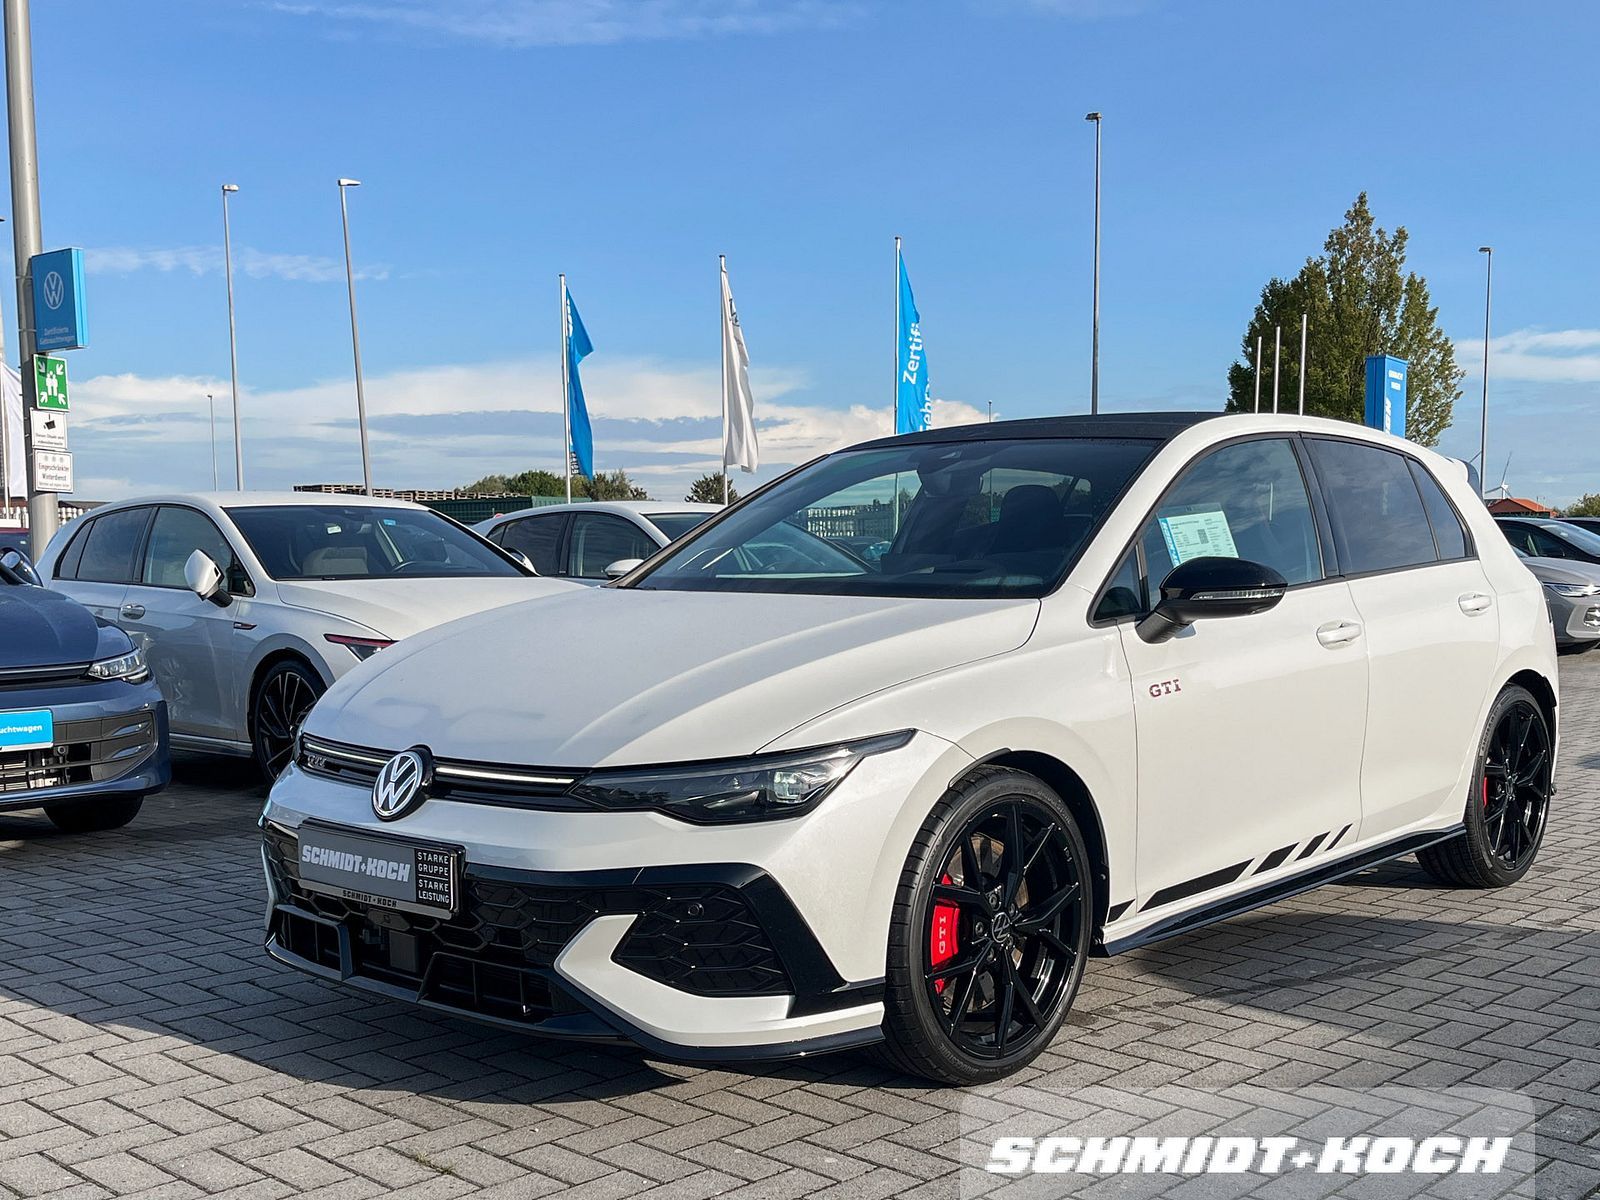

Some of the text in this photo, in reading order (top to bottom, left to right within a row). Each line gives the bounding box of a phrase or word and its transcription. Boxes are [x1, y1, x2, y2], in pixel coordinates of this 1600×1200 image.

[1149, 679, 1182, 698] GTI
[301, 845, 411, 882] SCHMIDT+KOCH
[417, 852, 449, 864] STARKE
[418, 863, 449, 876] GRUPPE
[418, 880, 449, 892] STARKE
[418, 889, 450, 904] LEISTUNG
[938, 916, 947, 955] GTI
